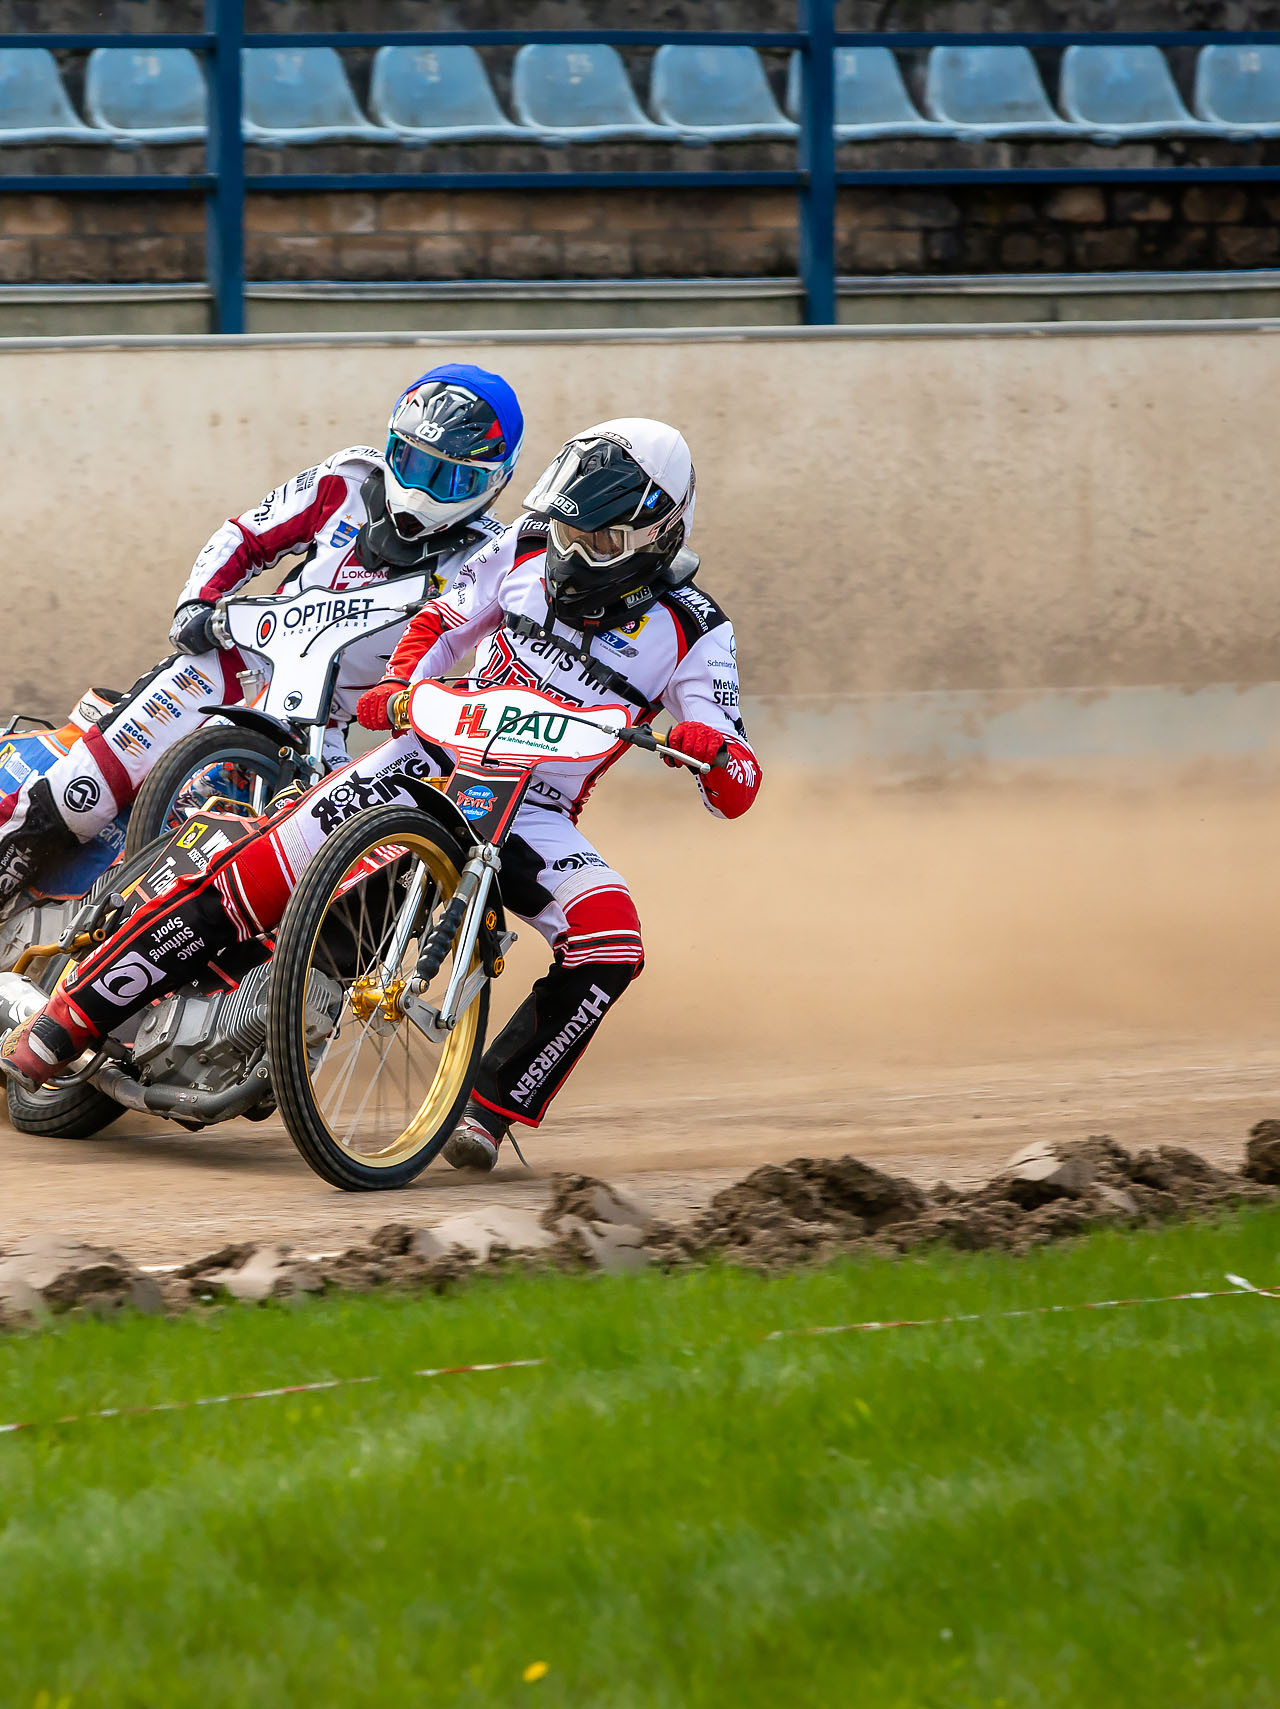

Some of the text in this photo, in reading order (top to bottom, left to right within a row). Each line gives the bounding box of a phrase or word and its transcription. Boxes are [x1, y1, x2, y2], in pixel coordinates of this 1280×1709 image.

[283, 598, 375, 629] OPTIBET
[183, 667, 214, 696] ERGOSS
[152, 692, 183, 719] ERGOSS
[121, 722, 152, 750] ERGOSS
[496, 705, 569, 744] BAU
[456, 790, 499, 812] DEVILS
[151, 916, 184, 944] Sport
[148, 926, 195, 963] Stiftung
[177, 937, 206, 961] ADAC
[509, 983, 611, 1104] HAUMERSEN
